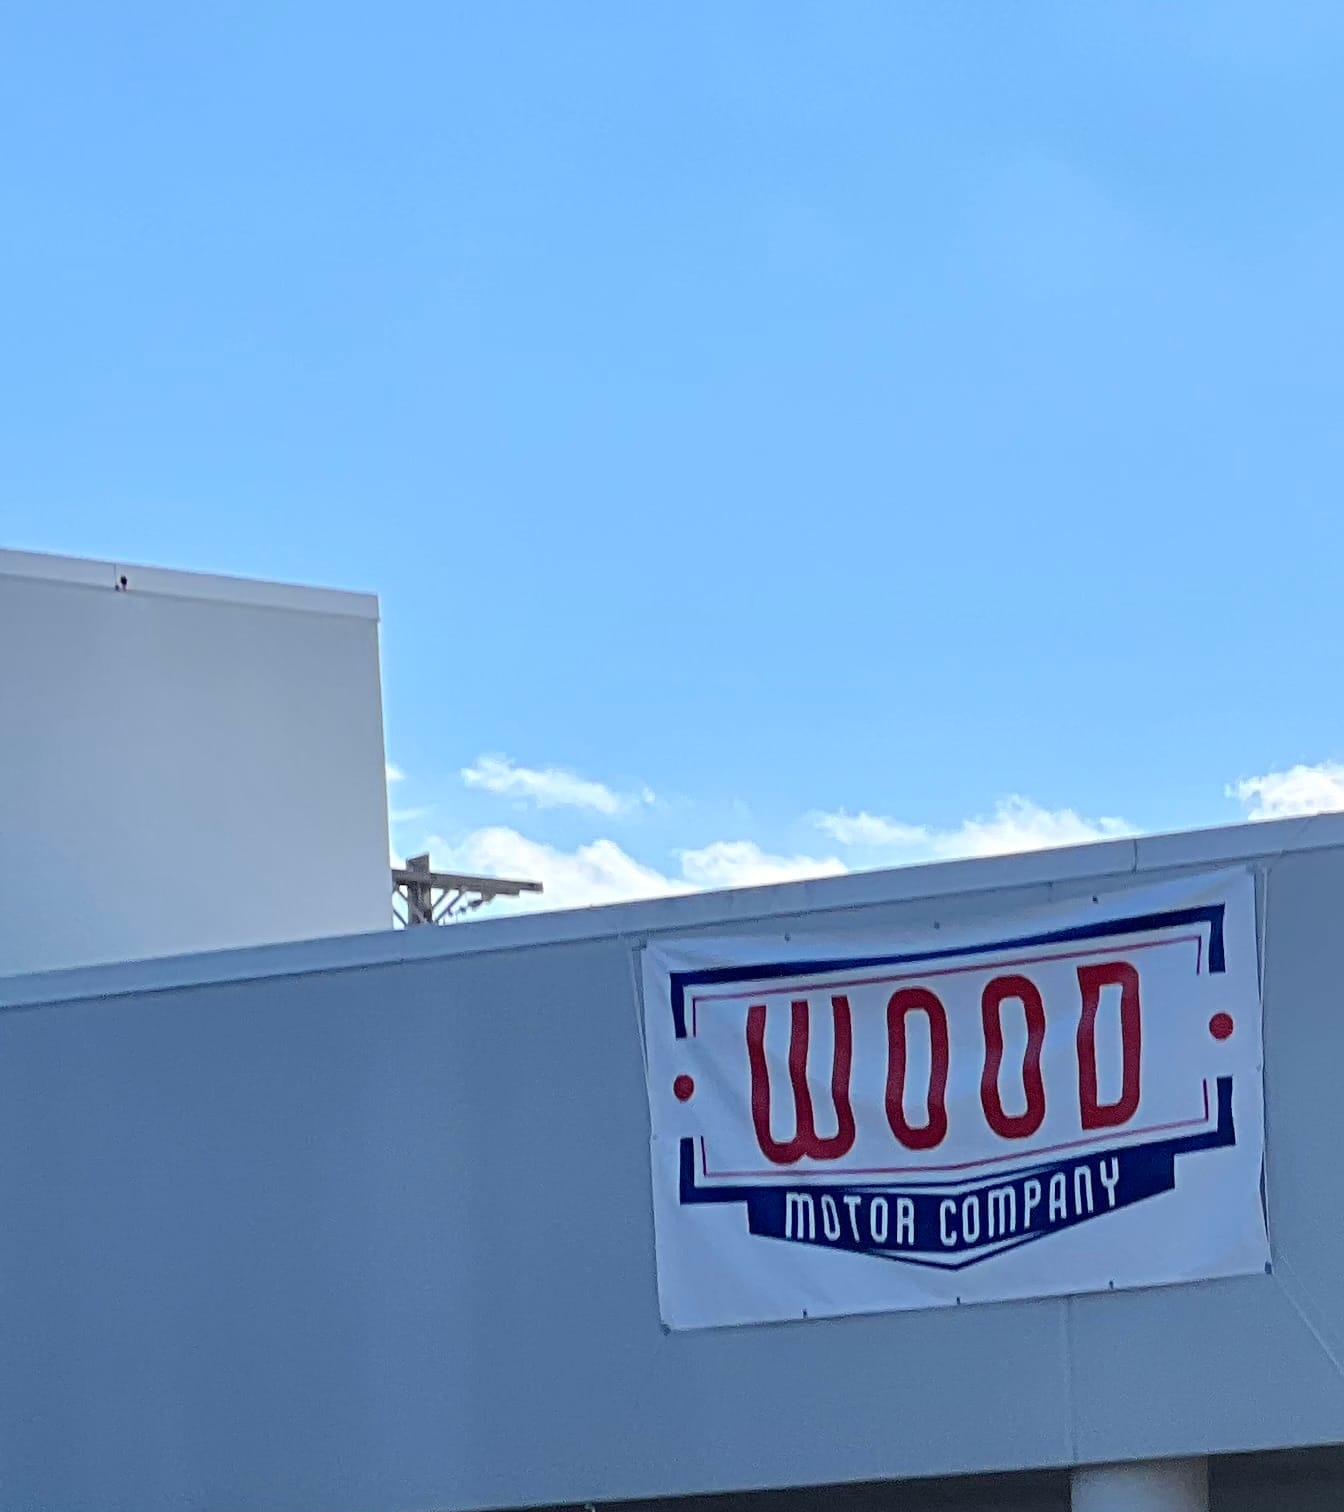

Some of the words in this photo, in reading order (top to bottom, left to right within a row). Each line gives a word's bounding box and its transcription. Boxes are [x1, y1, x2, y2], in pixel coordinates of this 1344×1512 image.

[746, 960, 1142, 1165] WOOD
[784, 1191, 915, 1247] MOTOR
[939, 1156, 1121, 1249] COMPANY
